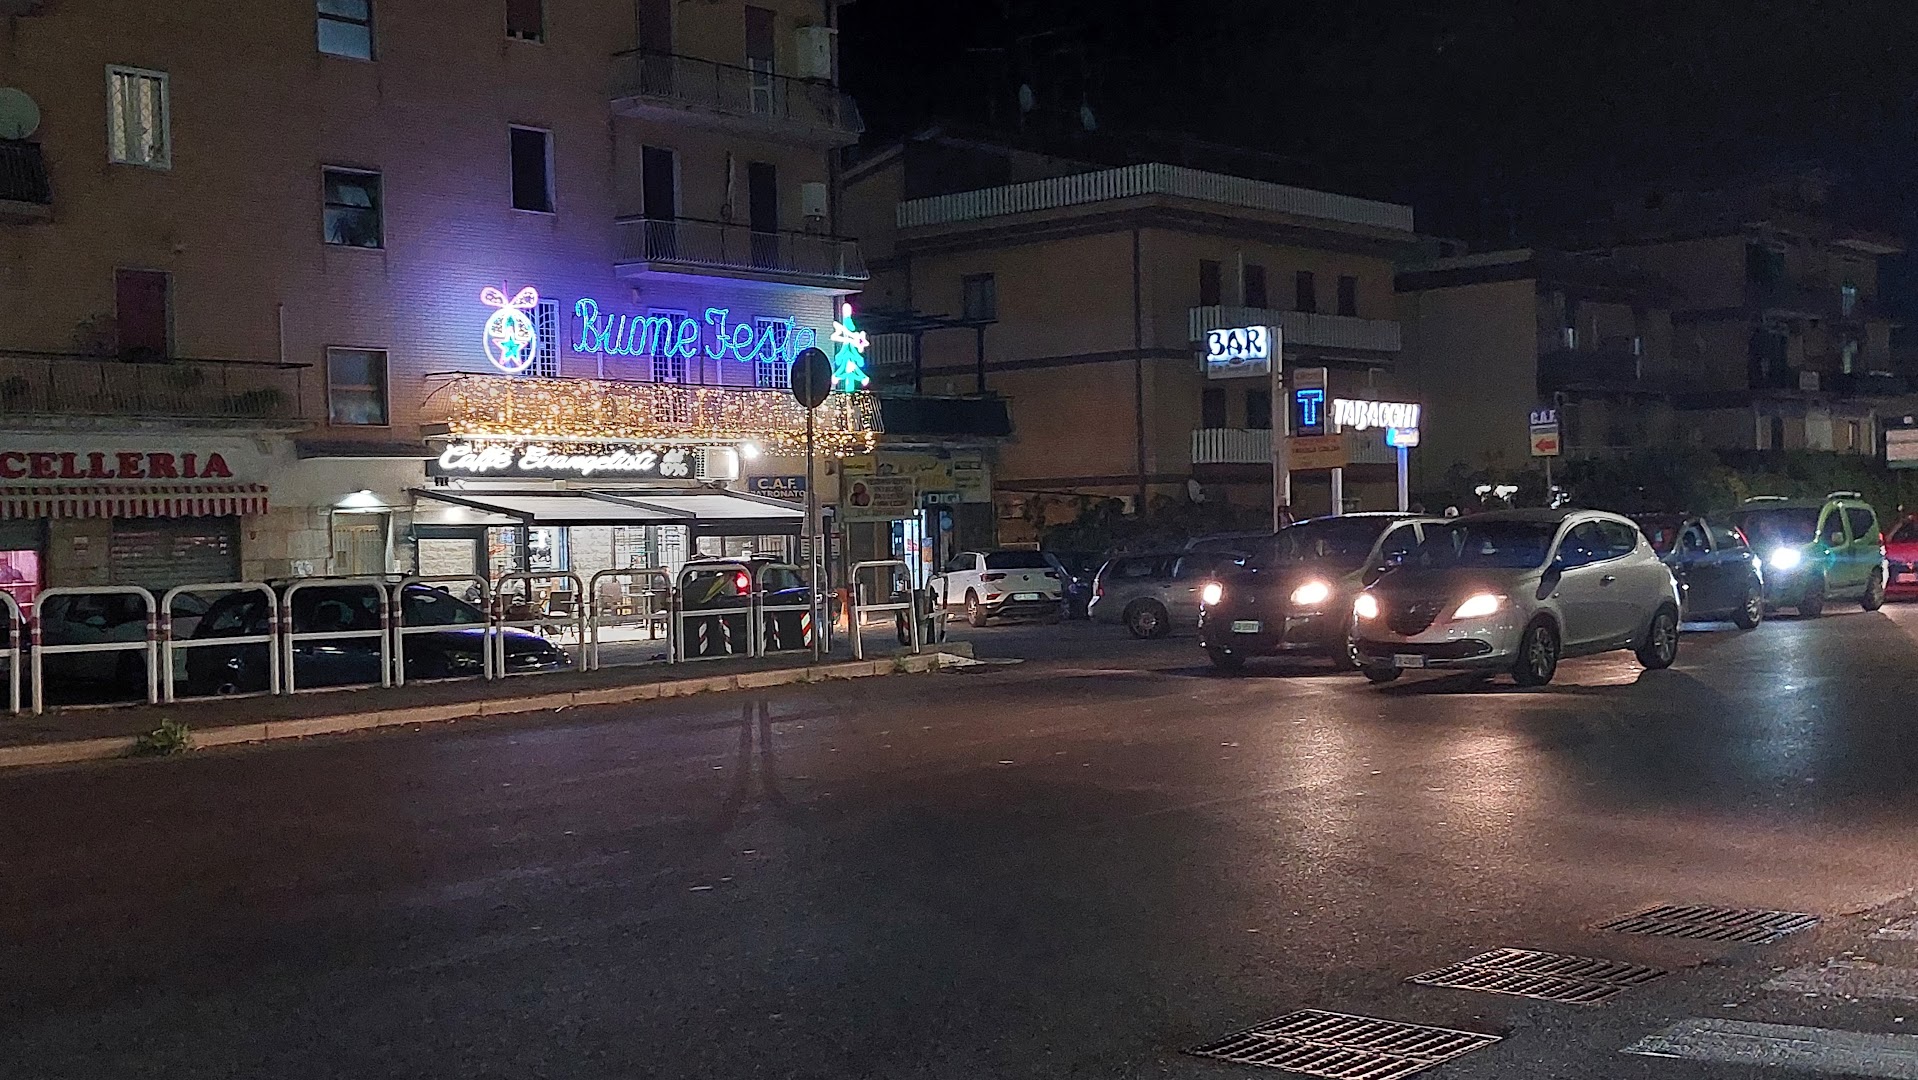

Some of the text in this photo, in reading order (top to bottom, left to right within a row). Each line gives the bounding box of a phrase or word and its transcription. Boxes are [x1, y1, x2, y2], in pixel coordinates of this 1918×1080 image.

[574, 297, 699, 358] Buone
[1206, 328, 1262, 356] BAR
[1296, 388, 1324, 426] T
[1333, 398, 1421, 431] TABACCHI
[0, 451, 234, 480] CELLERIA
[518, 445, 657, 476] Evangelisti
[757, 477, 797, 490] C.A.F.
